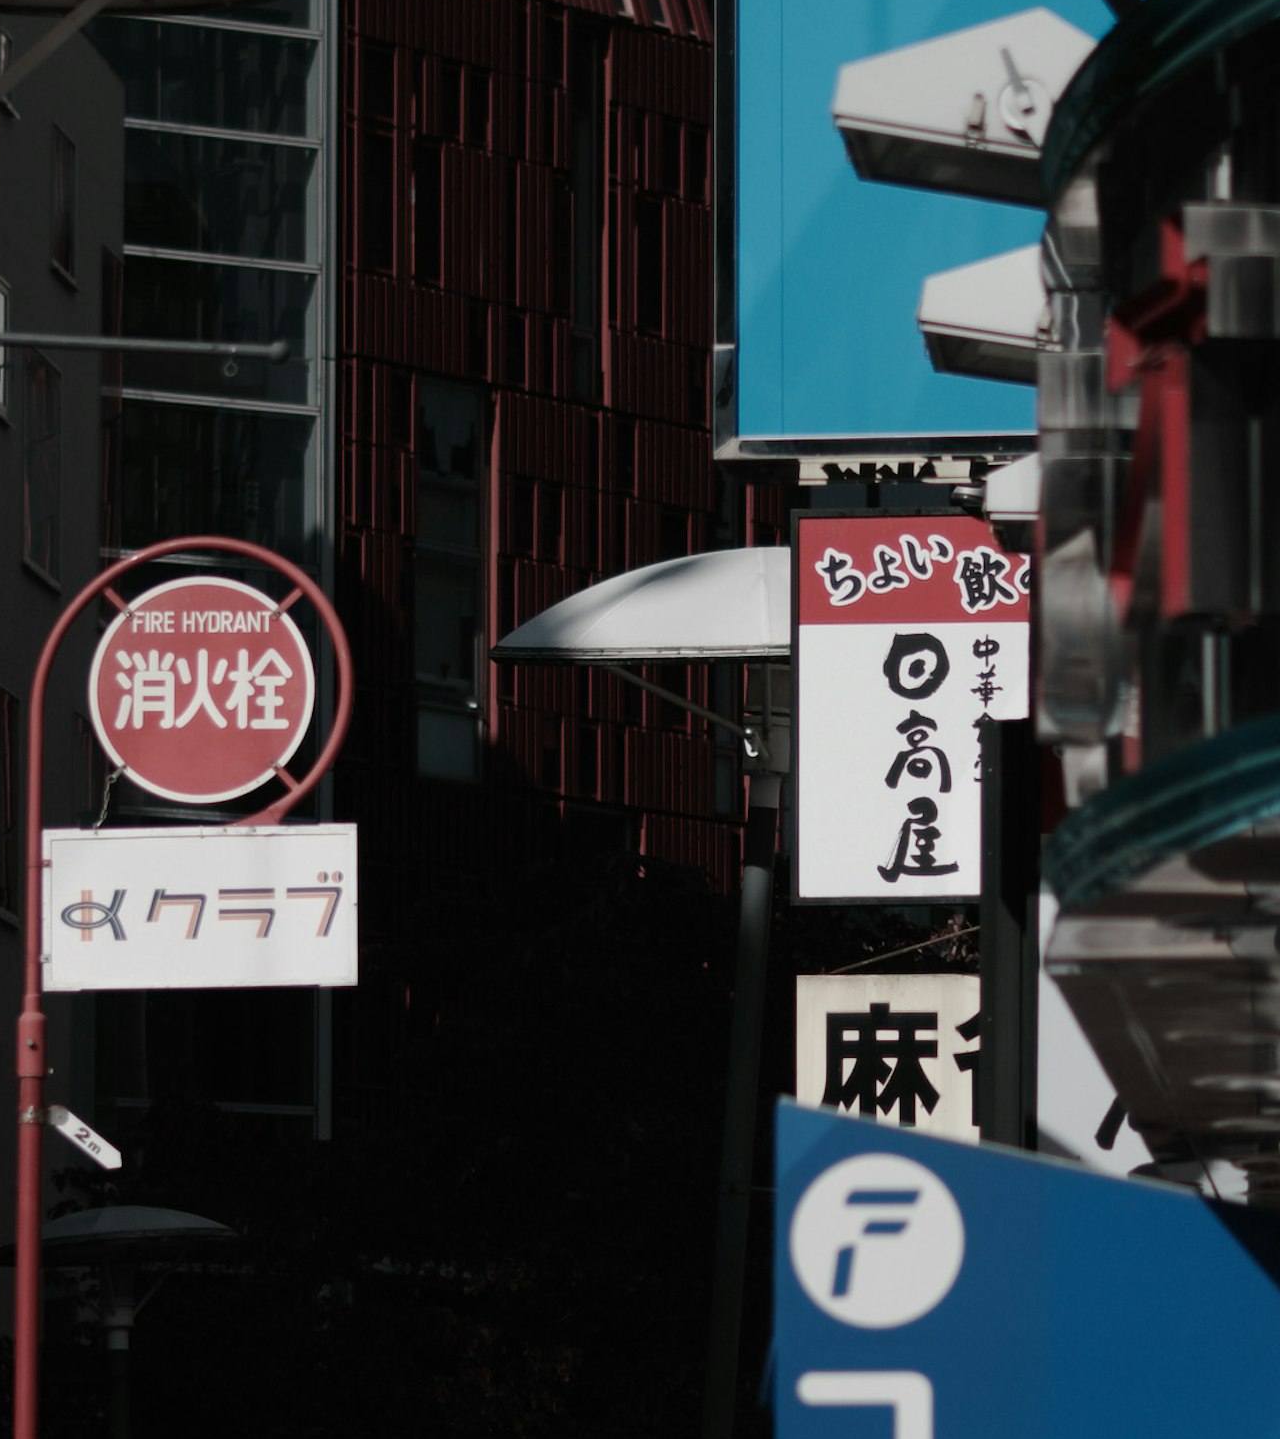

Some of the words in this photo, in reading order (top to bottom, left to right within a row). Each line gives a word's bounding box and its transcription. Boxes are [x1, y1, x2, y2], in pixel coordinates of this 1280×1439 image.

[815, 534, 1029, 614] ちょい飲
[132, 610, 175, 634] FIRE
[181, 610, 272, 634] HYDRANT
[115, 648, 291, 731] 消火栓
[878, 632, 959, 883] 日高屋
